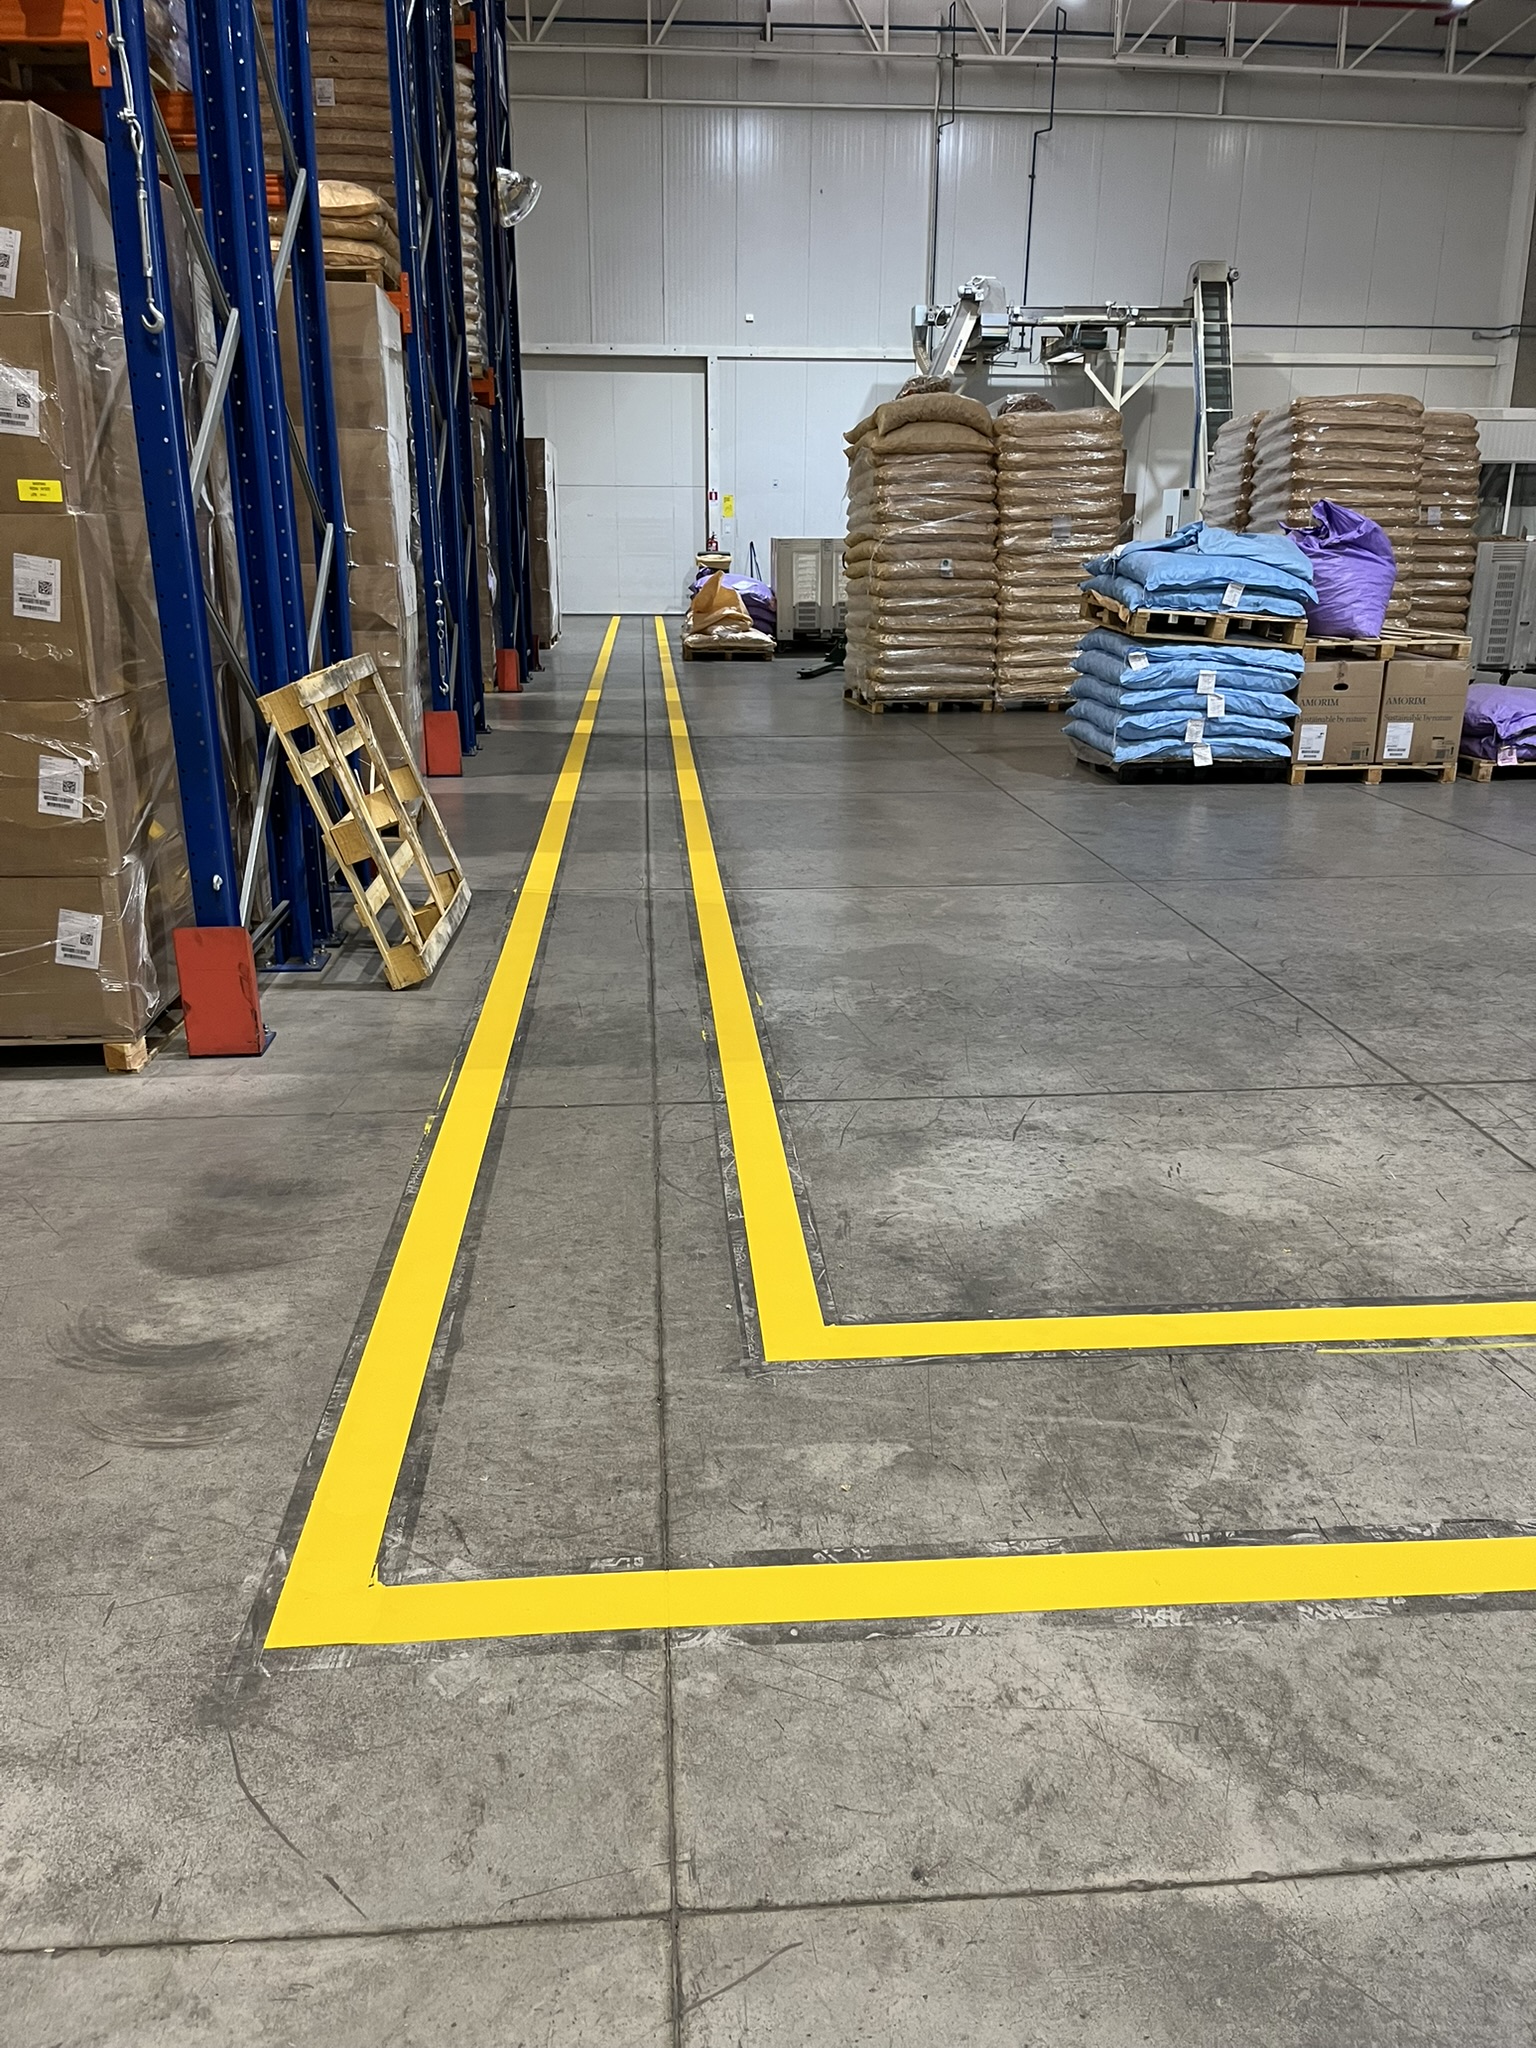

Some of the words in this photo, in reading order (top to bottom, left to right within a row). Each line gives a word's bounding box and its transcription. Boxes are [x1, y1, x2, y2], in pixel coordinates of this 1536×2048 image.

[1301, 698, 1339, 707] AMORIM
[1386, 697, 1426, 705] AMORIM
[1297, 715, 1336, 723] Sustainable
[1337, 715, 1344, 723] by
[1383, 714, 1422, 722] Sustainable
